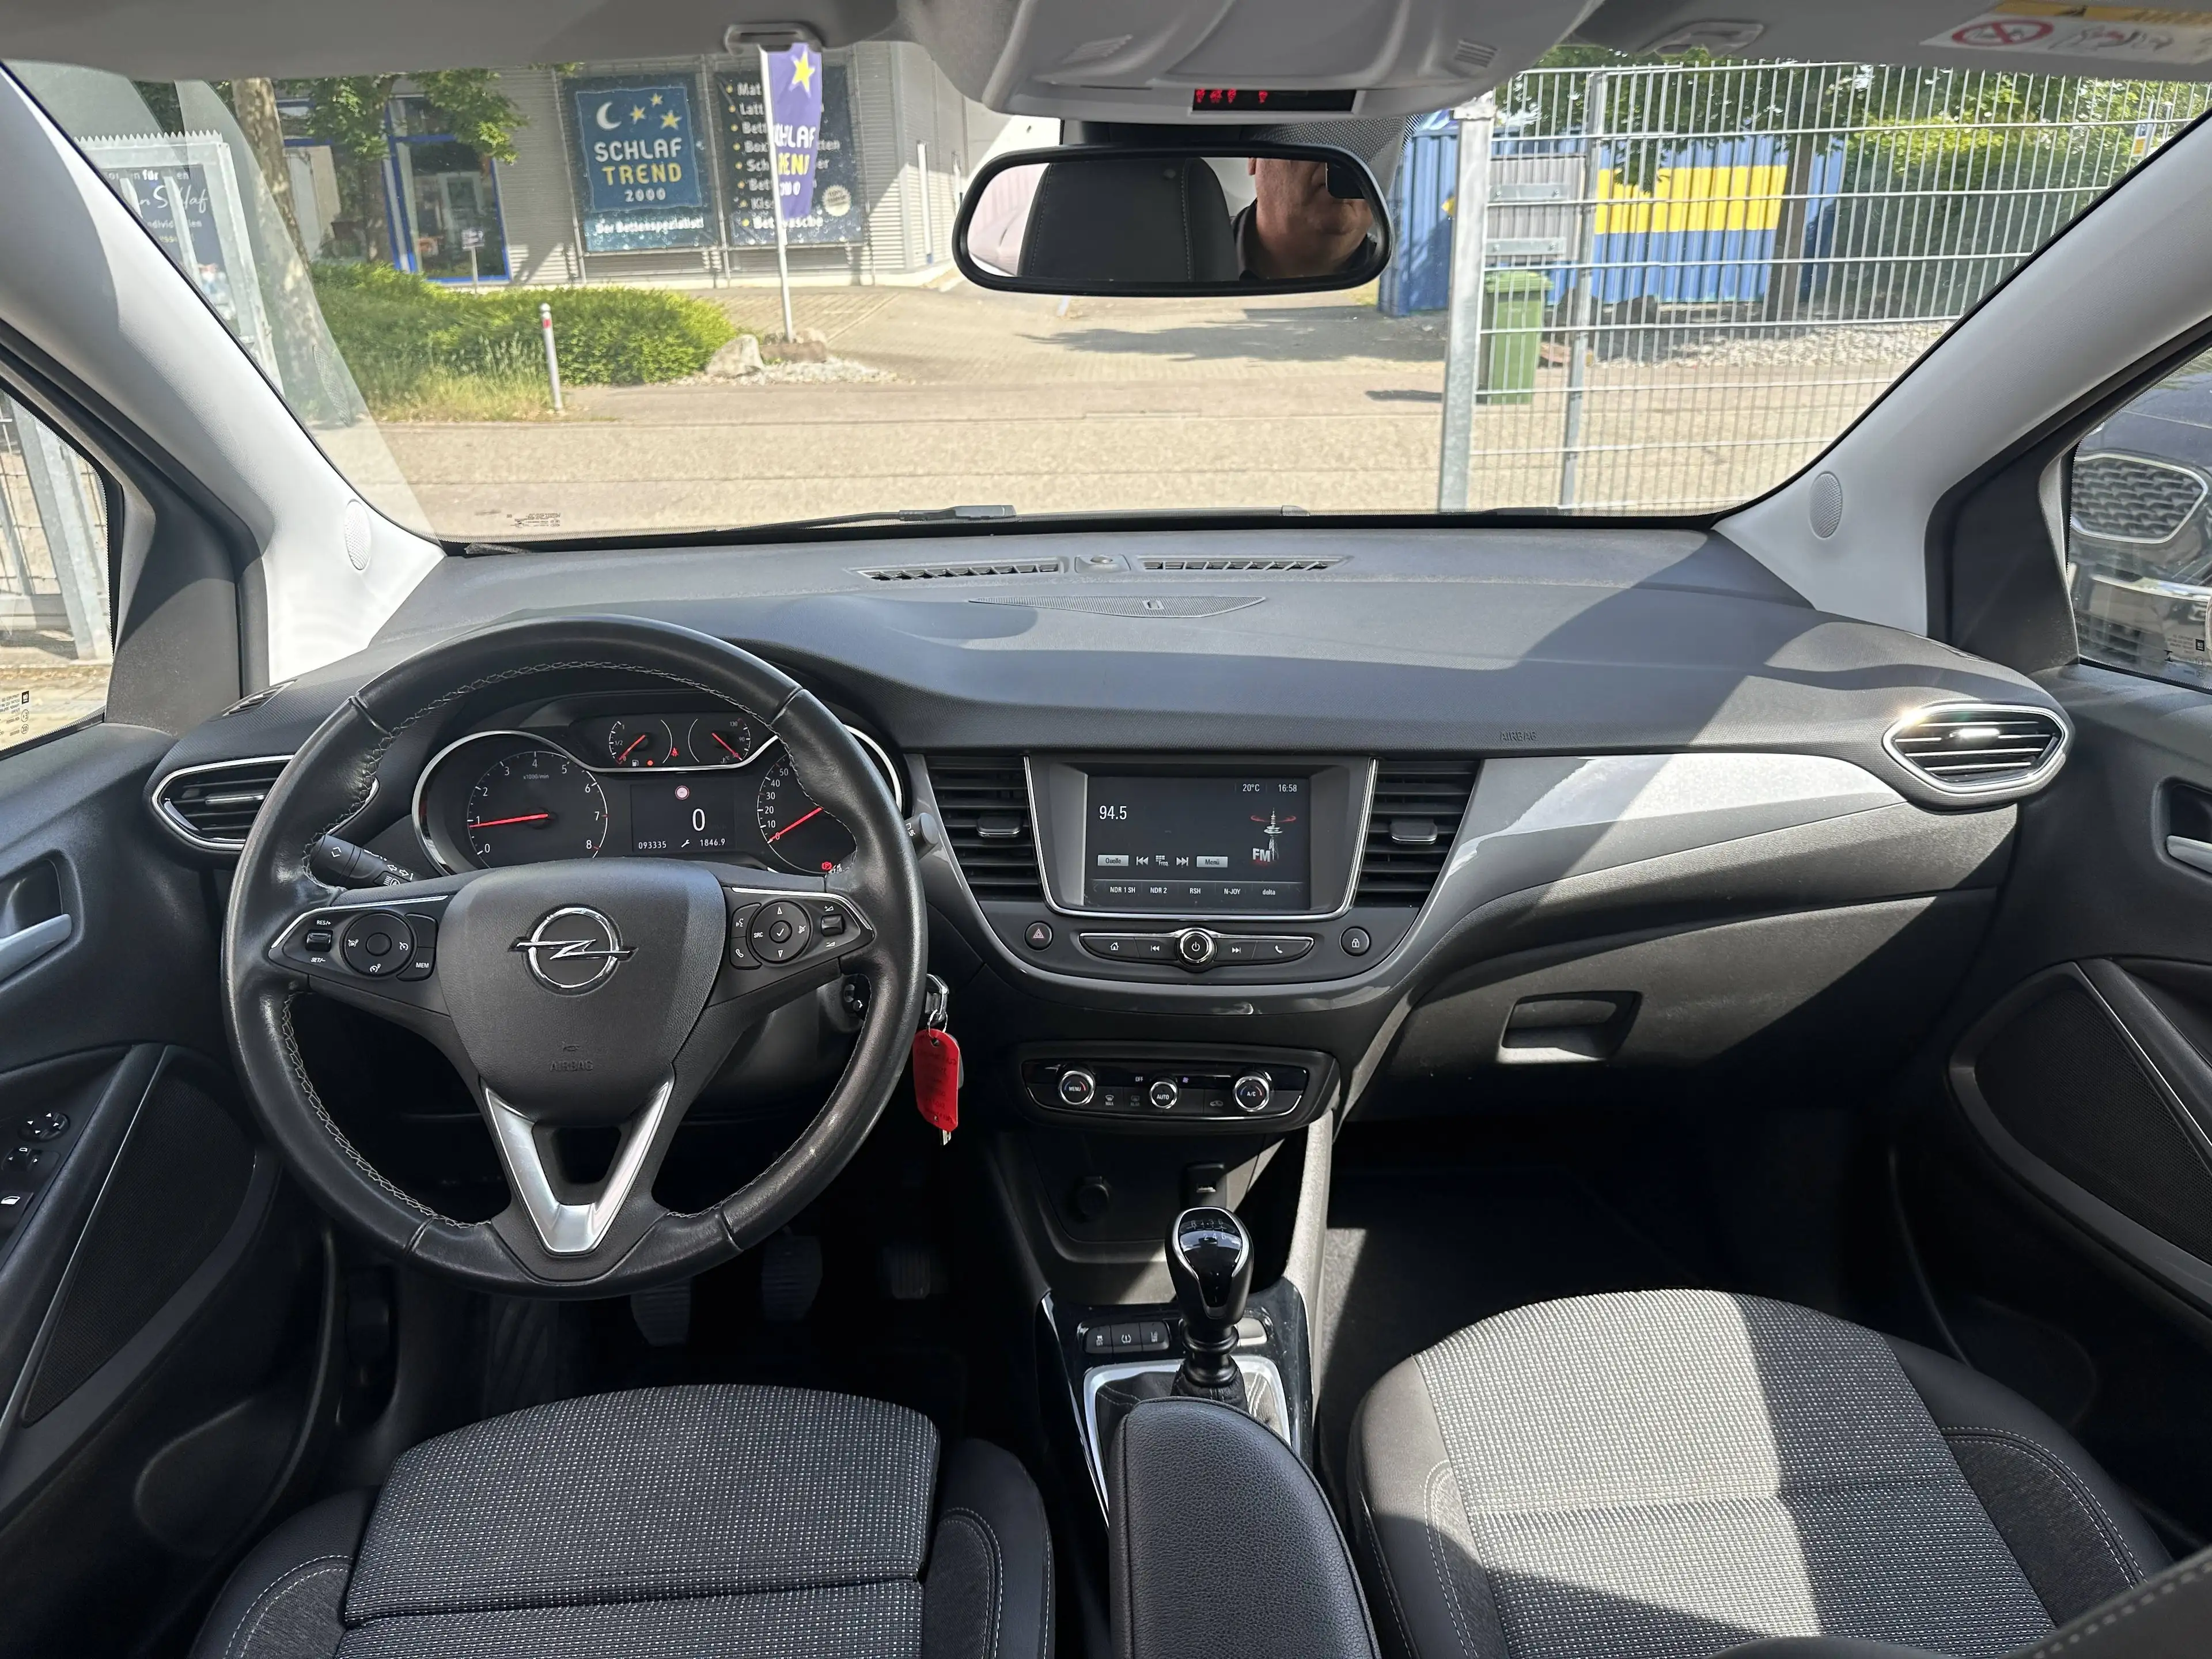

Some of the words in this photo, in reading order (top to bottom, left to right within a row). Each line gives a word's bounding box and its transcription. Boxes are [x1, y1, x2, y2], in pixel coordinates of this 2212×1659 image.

[594, 137, 682, 162] SCHLAF
[601, 162, 682, 185] TREND
[624, 188, 666, 202] 2000
[1499, 732, 1537, 741] AIRBAG
[532, 759, 538, 768] 4
[504, 767, 510, 776] 3
[562, 765, 567, 774] 5
[779, 768, 789, 777] 50
[770, 778, 781, 787] 40
[482, 787, 488, 797] 2
[585, 784, 591, 793] 6
[1243, 783, 1260, 792] 20°C
[1278, 784, 1297, 792] 16:58
[766, 791, 776, 800] 30
[764, 806, 774, 815] 20
[1099, 805, 1127, 820] 94.5
[476, 816, 480, 824] 1
[594, 812, 600, 821] 7
[692, 808, 706, 831] 0
[767, 820, 776, 828] 10
[586, 839, 592, 849] 8
[638, 841, 666, 849] 093335
[700, 838, 725, 847] 1846.9
[484, 843, 490, 853] 0
[1252, 848, 1271, 862] FM
